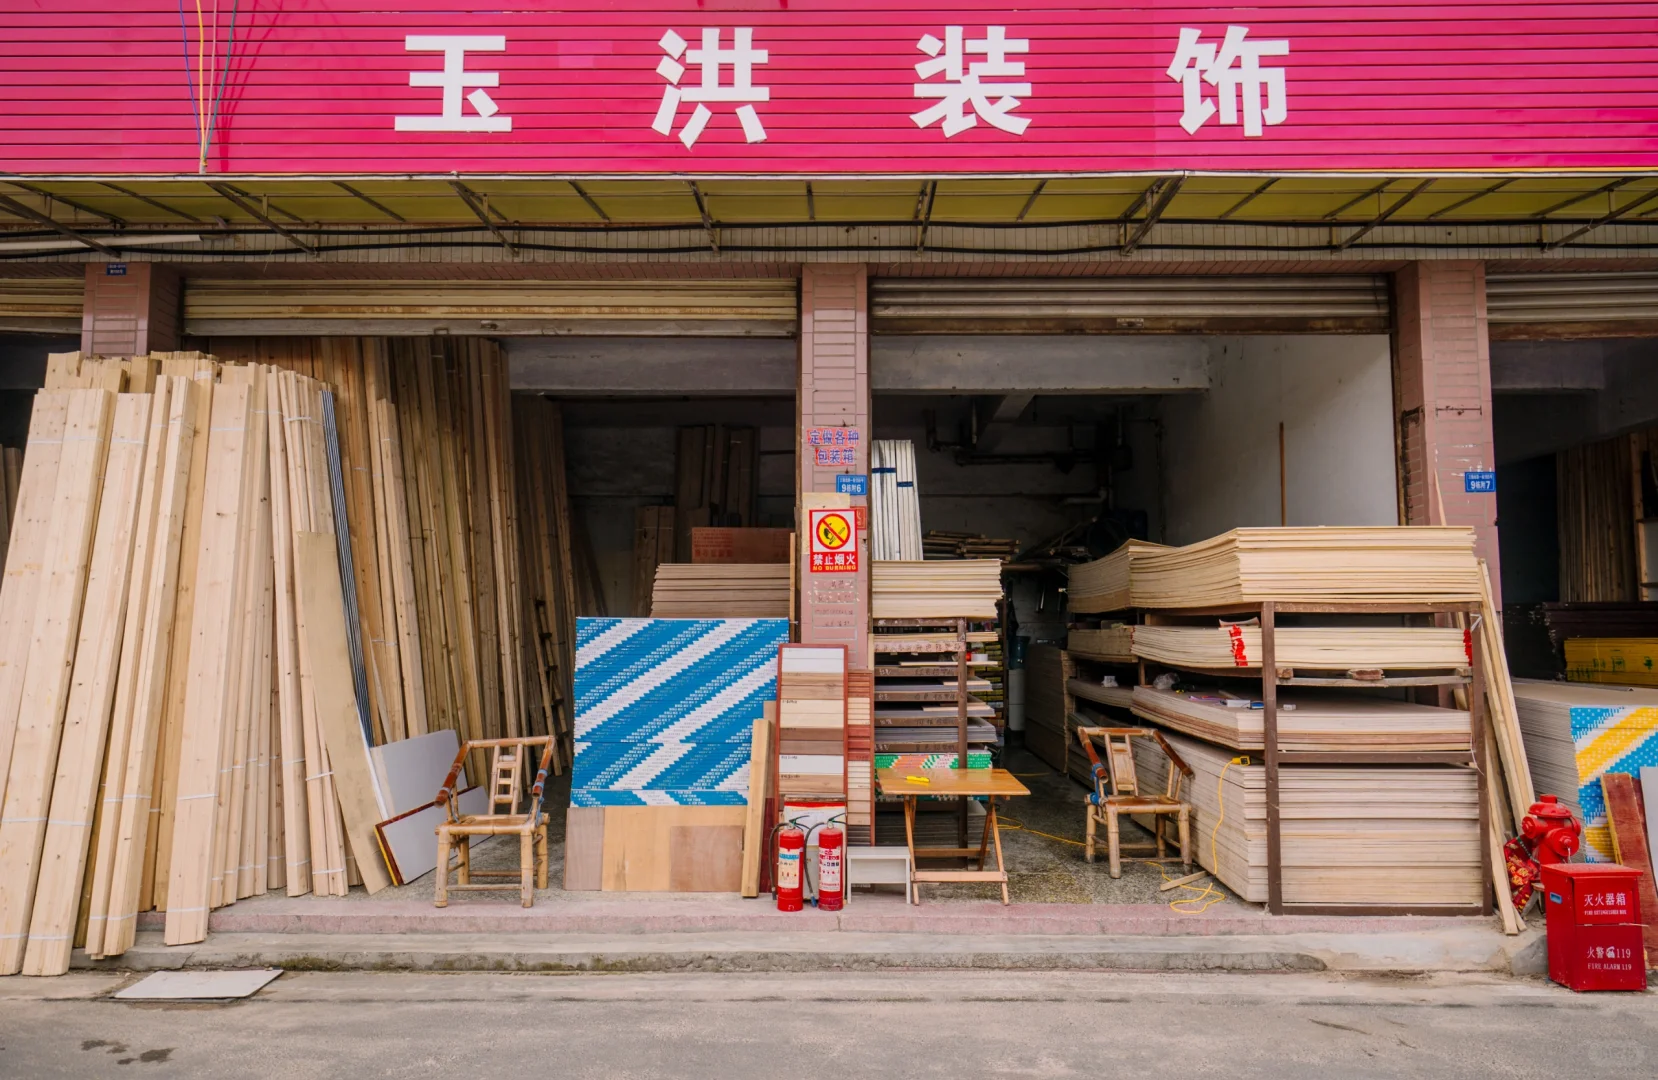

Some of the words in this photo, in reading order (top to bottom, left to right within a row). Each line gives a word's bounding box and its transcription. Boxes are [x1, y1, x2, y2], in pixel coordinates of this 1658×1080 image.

[394, 25, 1290, 151] 玉洪装饰
[810, 429, 859, 445] 定做各种
[818, 448, 854, 464] 包装箱
[813, 553, 856, 566] 禁止烟火
[1584, 893, 1626, 906] 灭火器箱
[1586, 946, 1605, 959] 火警
[1616, 948, 1631, 959] 119
